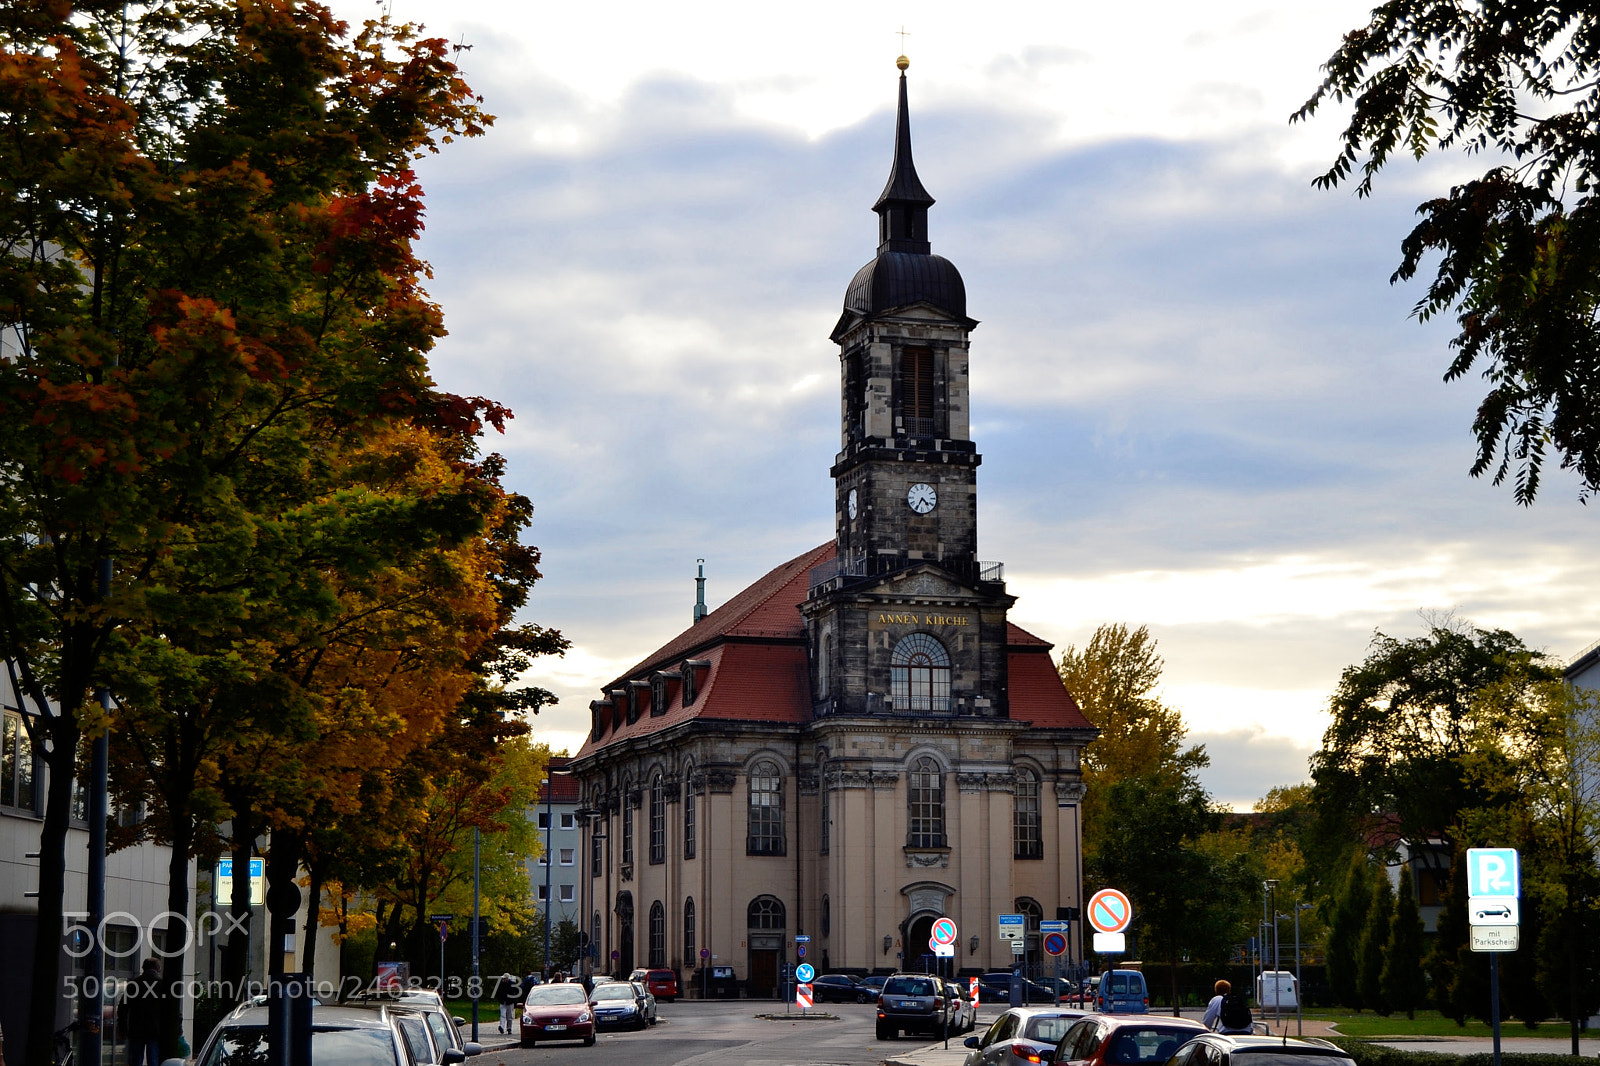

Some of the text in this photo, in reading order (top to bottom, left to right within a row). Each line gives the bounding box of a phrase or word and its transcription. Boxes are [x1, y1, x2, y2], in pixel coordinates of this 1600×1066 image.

[878, 614, 969, 625] ANNEN KIRCHE
[1475, 938, 1515, 946] Parkschein
